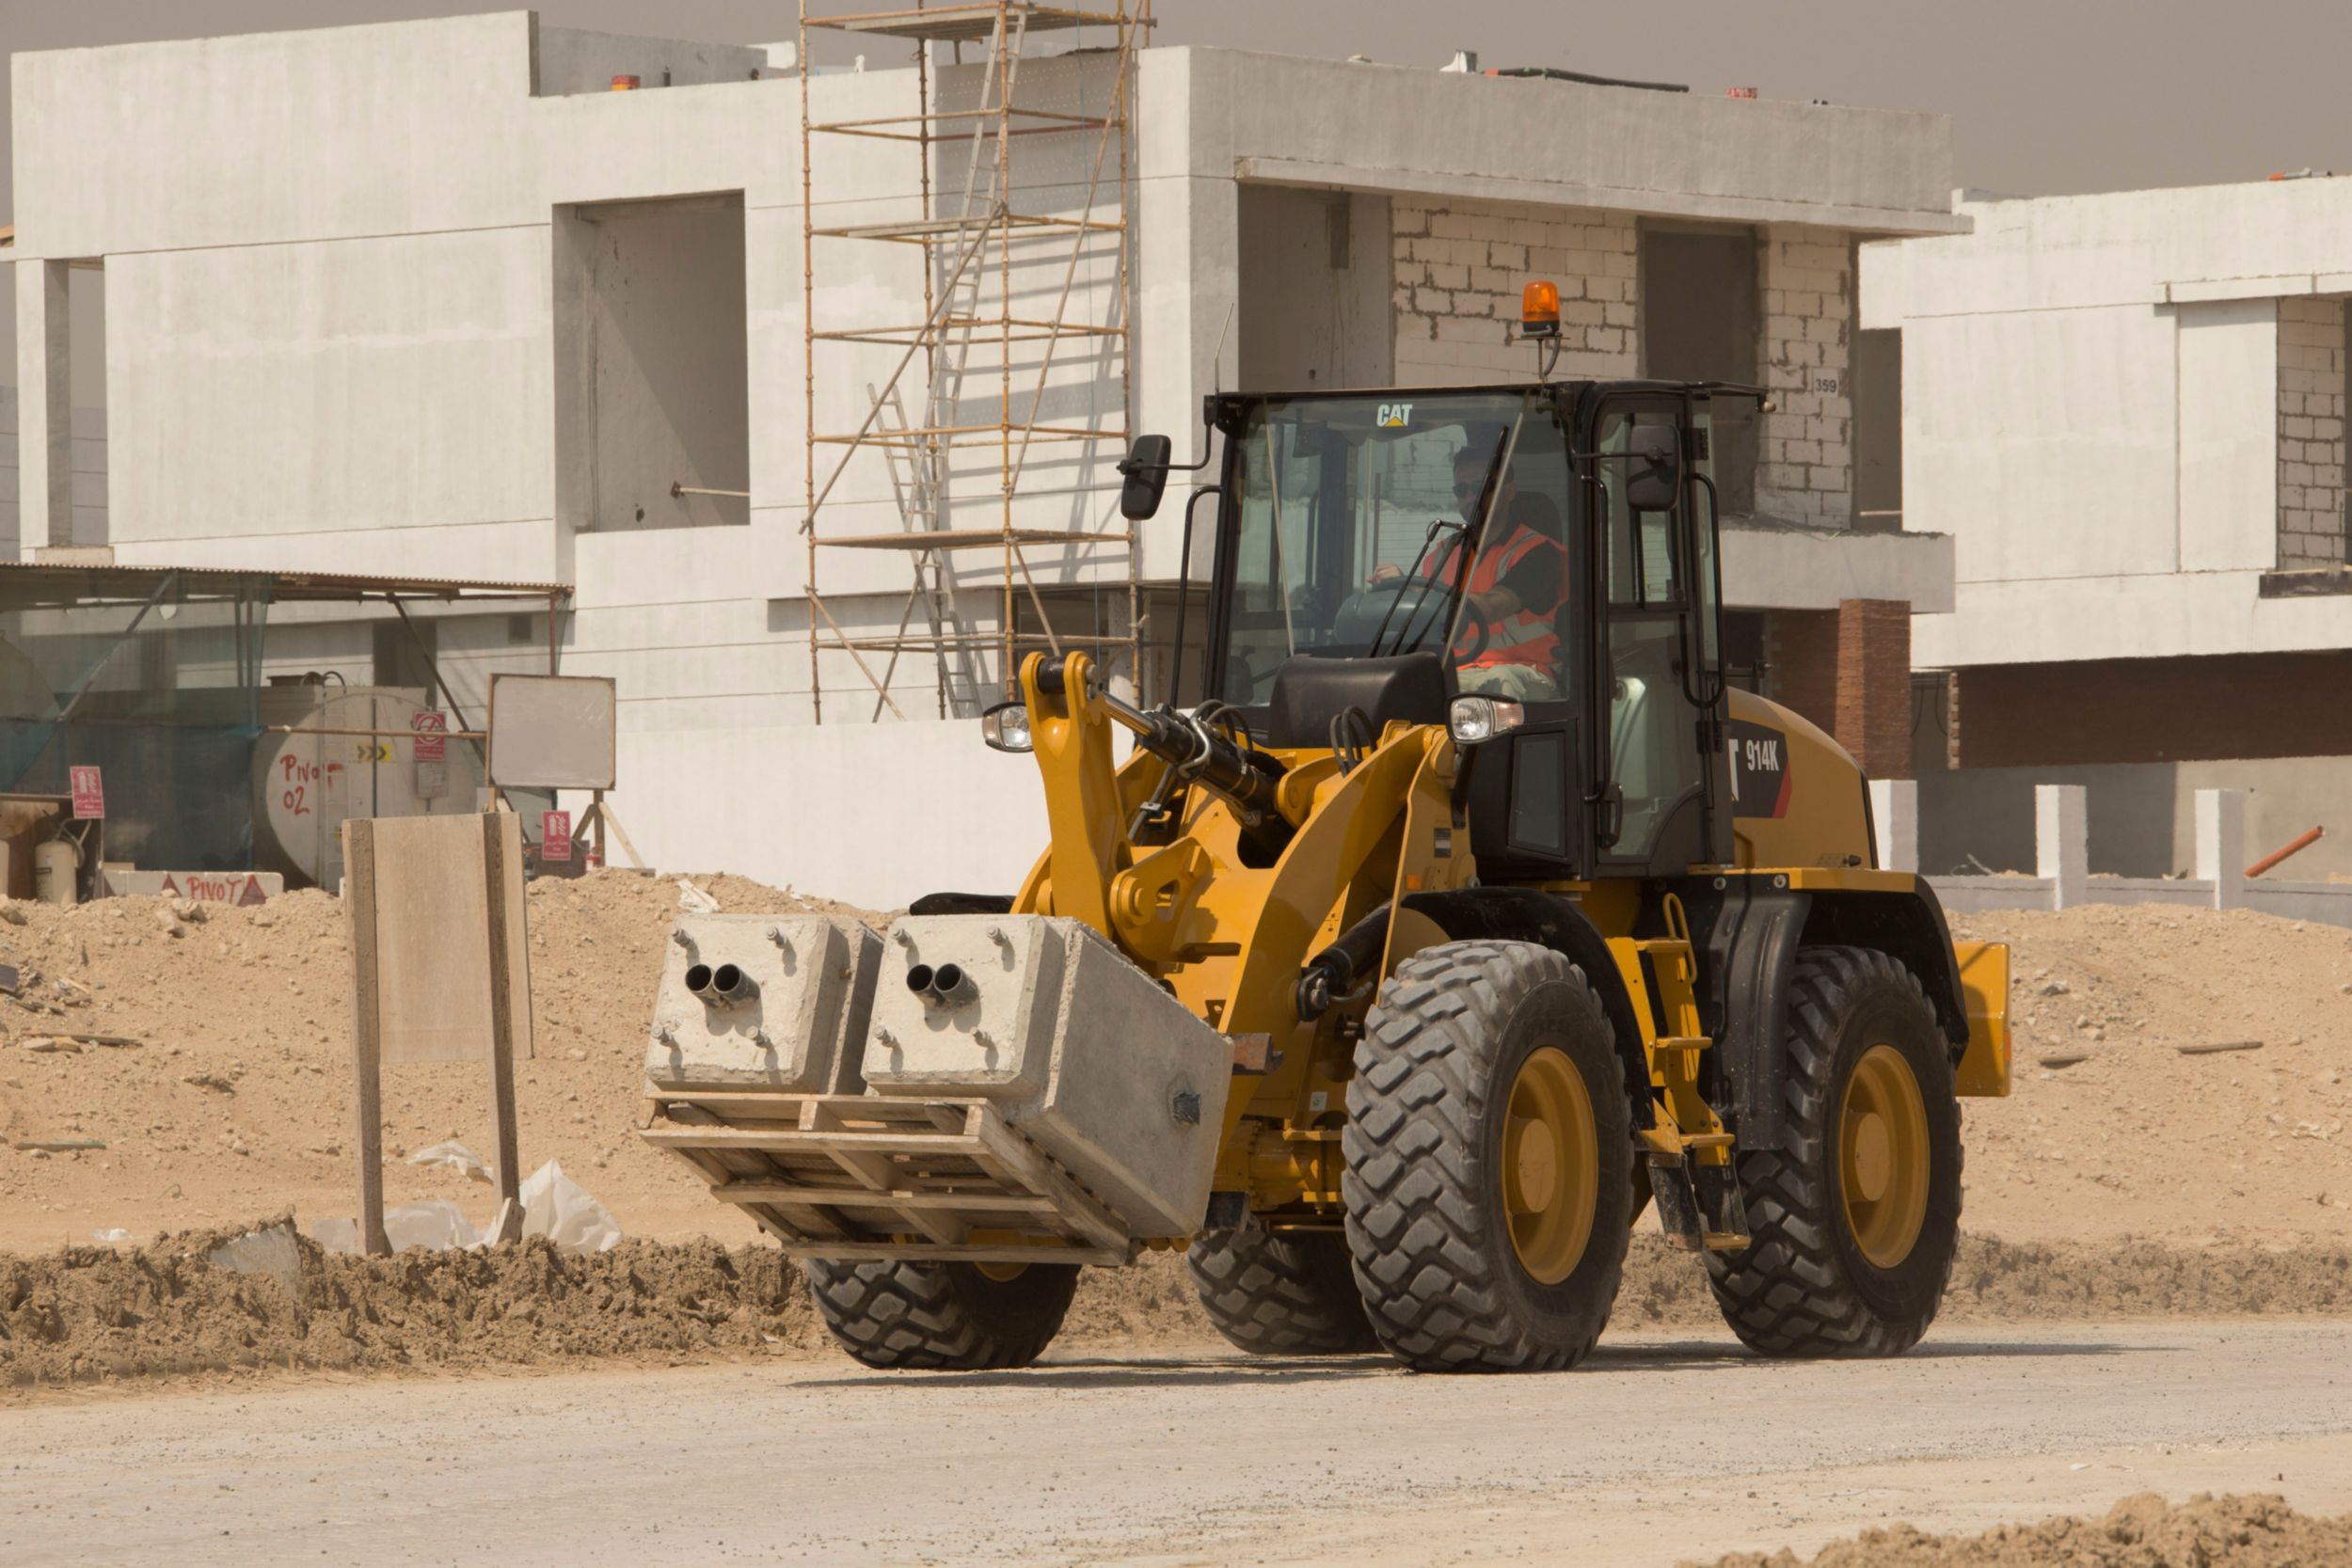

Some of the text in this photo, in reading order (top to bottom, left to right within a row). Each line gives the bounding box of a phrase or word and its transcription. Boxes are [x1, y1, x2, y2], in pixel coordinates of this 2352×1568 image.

[1816, 378, 1836, 393] 359
[1376, 404, 1413, 427] CAT
[1746, 739, 1779, 771] 914K
[283, 785, 310, 816] 02
[186, 876, 242, 904] PIVOT
